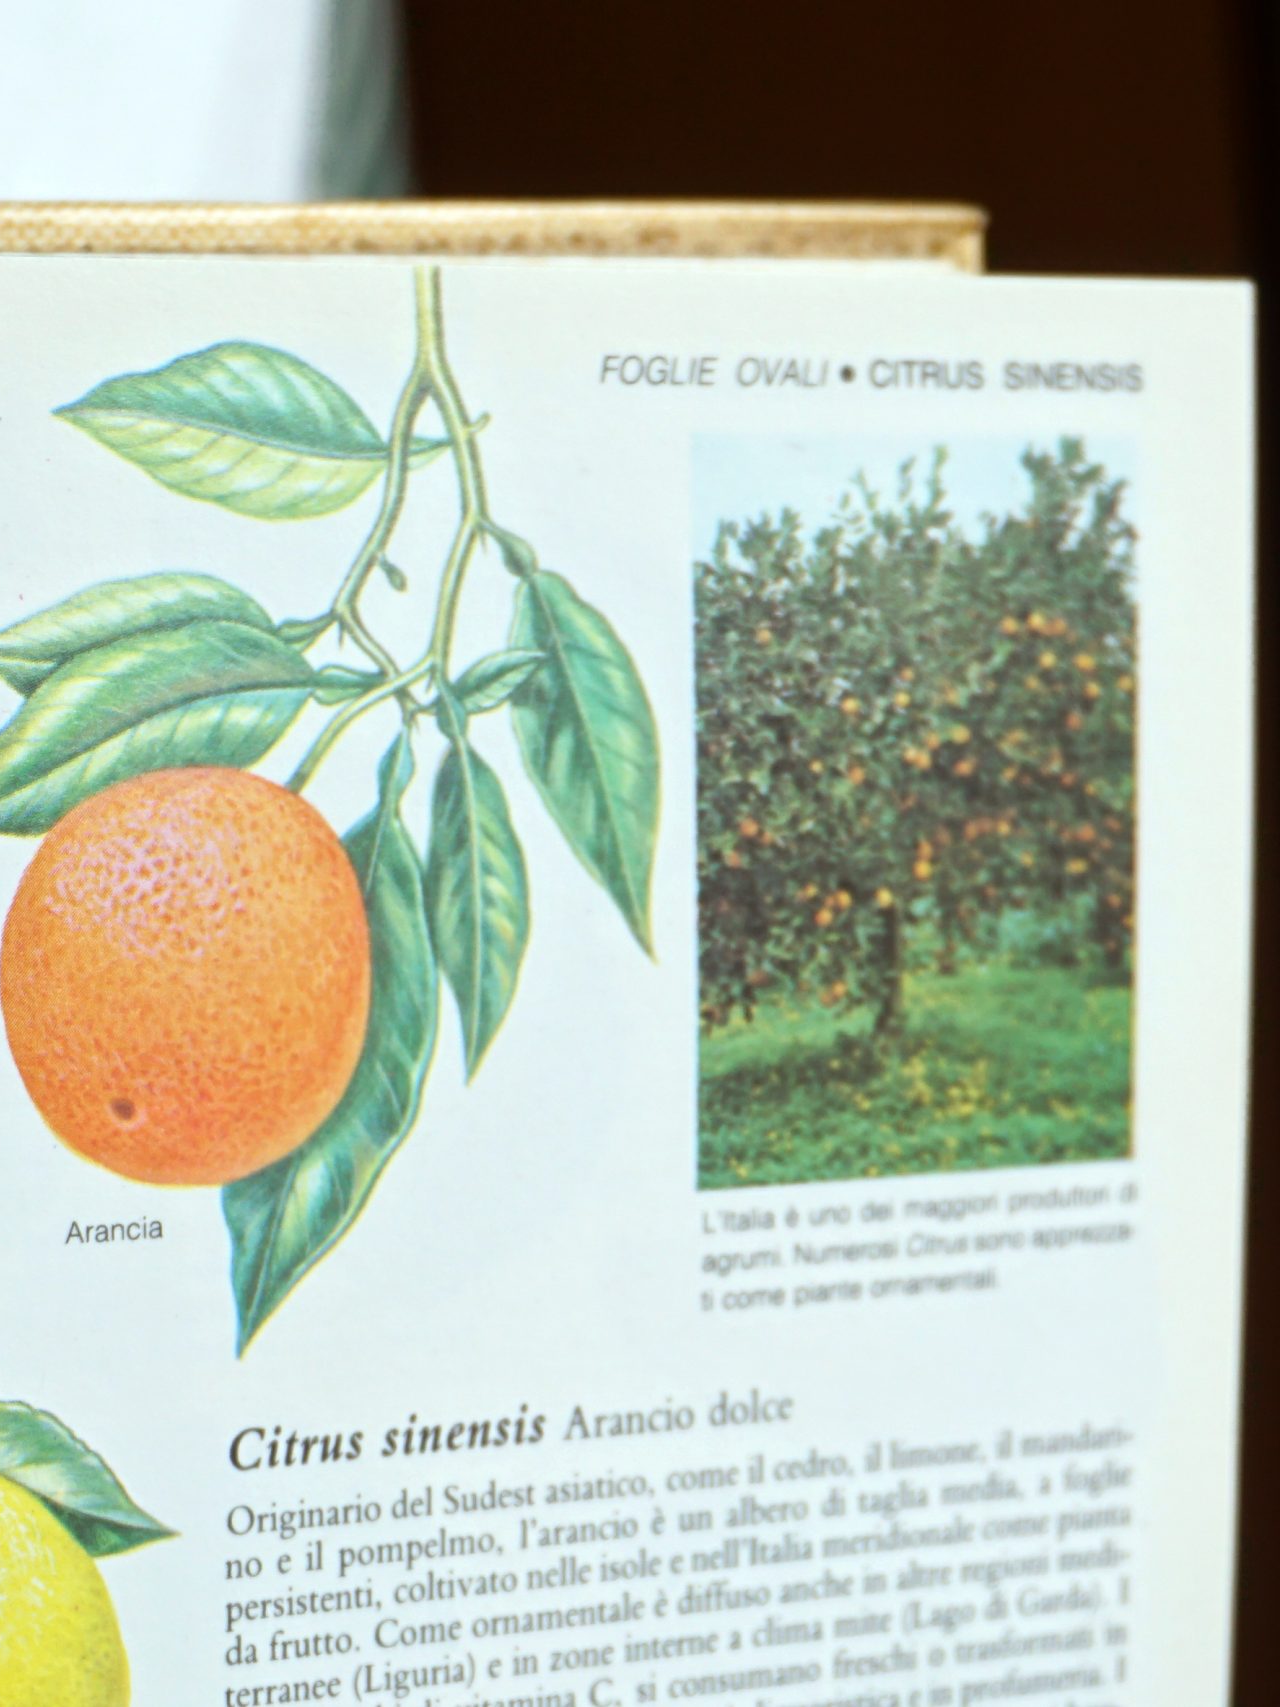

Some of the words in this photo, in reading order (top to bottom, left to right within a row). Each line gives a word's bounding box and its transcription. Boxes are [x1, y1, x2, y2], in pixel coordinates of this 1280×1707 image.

[599, 354, 718, 387] FOGLIE
[736, 356, 829, 388] OVALI
[869, 358, 984, 391] CITRUS
[1002, 361, 1144, 393] SINENSIS
[65, 1215, 164, 1245] Arancia
[228, 1424, 365, 1473] Citrus
[380, 1402, 546, 1458] sinensis
[564, 1396, 696, 1441] Arancio
[710, 1387, 795, 1427] dolce
[226, 1492, 382, 1540] Originario
[391, 1485, 433, 1521] del
[443, 1479, 536, 1515] Sudest
[545, 1466, 656, 1505] asiatico,
[666, 1465, 740, 1493] come
[747, 1453, 764, 1485] il
[226, 1555, 263, 1580] no
[277, 1552, 292, 1575] e
[305, 1539, 324, 1573] il
[338, 1527, 503, 1579] pompelmo,
[521, 1509, 639, 1549] l'arancio
[650, 1506, 666, 1537] è
[679, 1509, 713, 1534] un
[725, 1493, 810, 1529] albero
[225, 1576, 383, 1633] persistenti,
[392, 1569, 519, 1605] coltivato
[526, 1555, 592, 1591] nelle
[599, 1547, 662, 1584] isole
[669, 1554, 684, 1576] e
[225, 1633, 258, 1667] da
[268, 1629, 360, 1662] frutto.
[373, 1617, 463, 1649] Come
[471, 1590, 646, 1639] ornamentale
[652, 1588, 668, 1619] è
[677, 1579, 771, 1616] diffuso
[224, 1677, 343, 1707] terranee
[352, 1650, 477, 1702] (Liguria)
[487, 1657, 502, 1679] e
[512, 1645, 538, 1677] in
[549, 1644, 616, 1674] zone
[624, 1632, 720, 1664] interne
[728, 1631, 742, 1651] a
